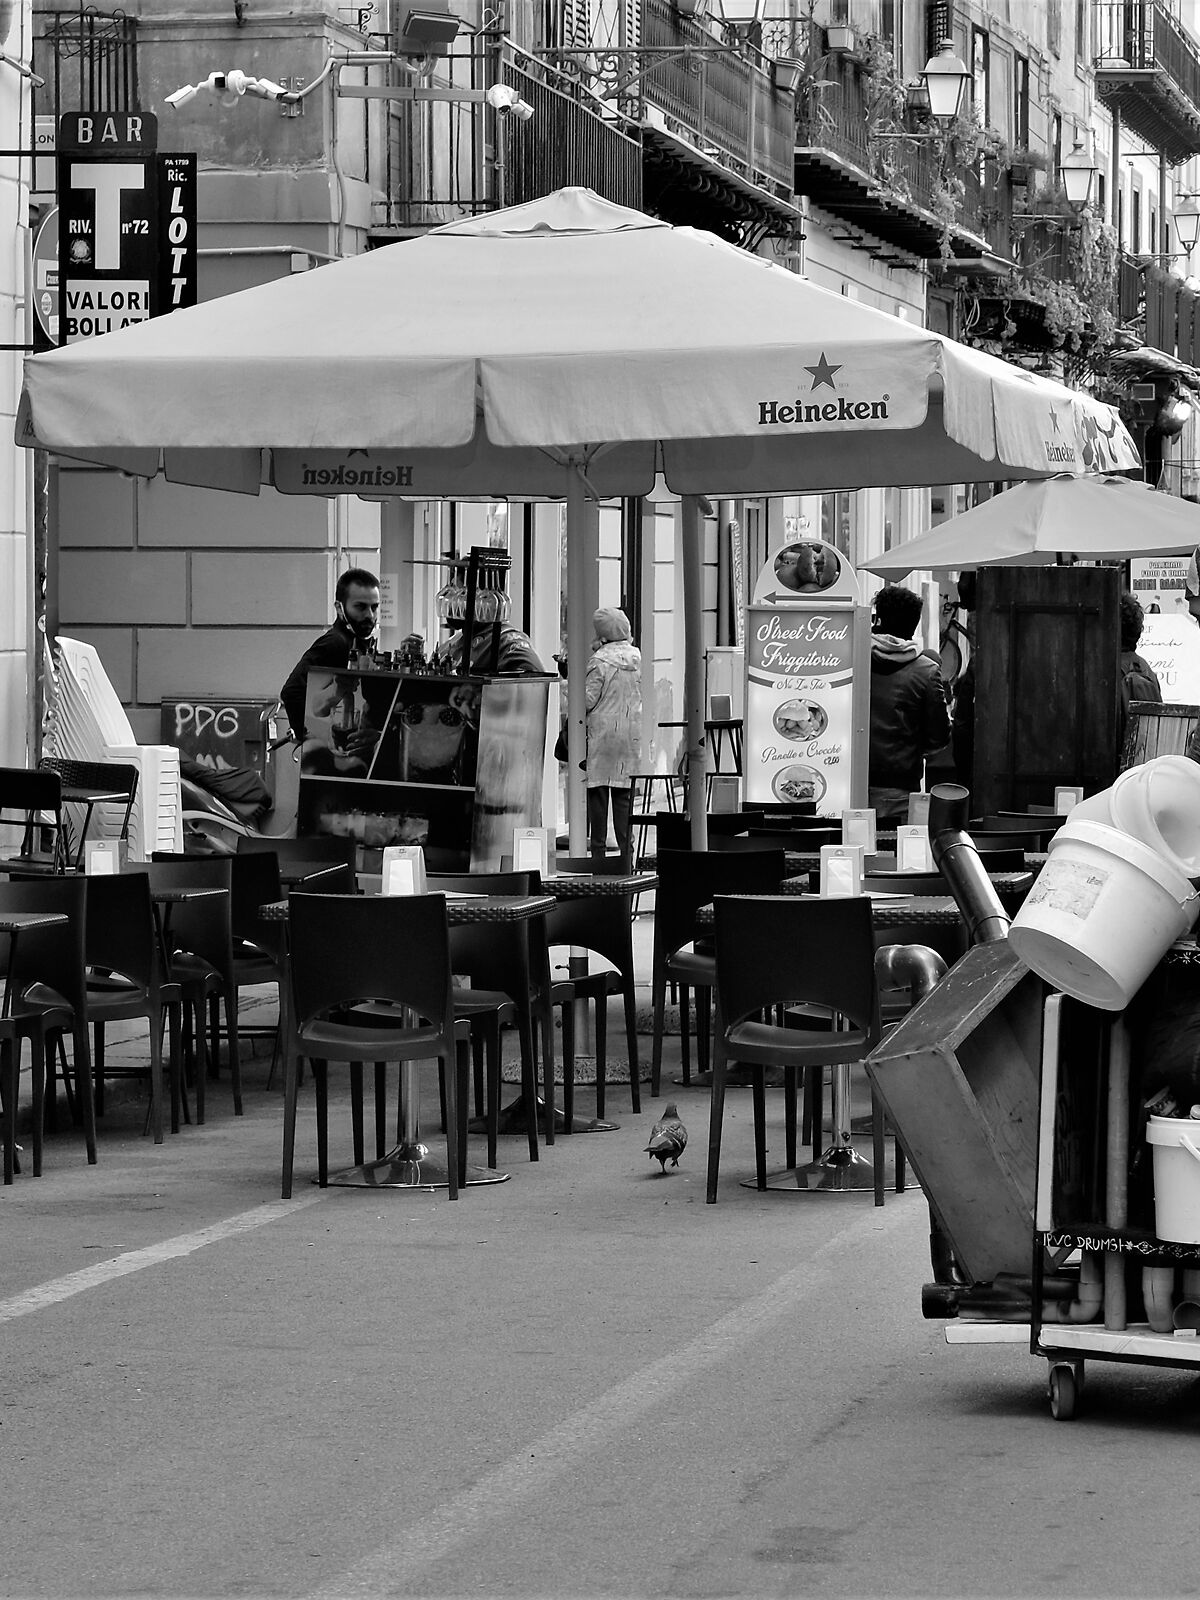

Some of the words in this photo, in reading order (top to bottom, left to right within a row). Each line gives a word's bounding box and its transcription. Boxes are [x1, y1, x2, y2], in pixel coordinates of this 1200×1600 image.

[77, 116, 142, 143] BAR
[167, 169, 188, 182] Ric.
[69, 219, 92, 234] RIV.
[70, 163, 145, 270] T
[168, 187, 188, 313] LOTT
[67, 291, 149, 310] VALORI
[758, 397, 889, 425] Heineken
[756, 615, 805, 642] Street
[805, 615, 849, 642] Food
[761, 641, 842, 673] Friggitoria
[1077, 1236, 1118, 1252] DRUMS
